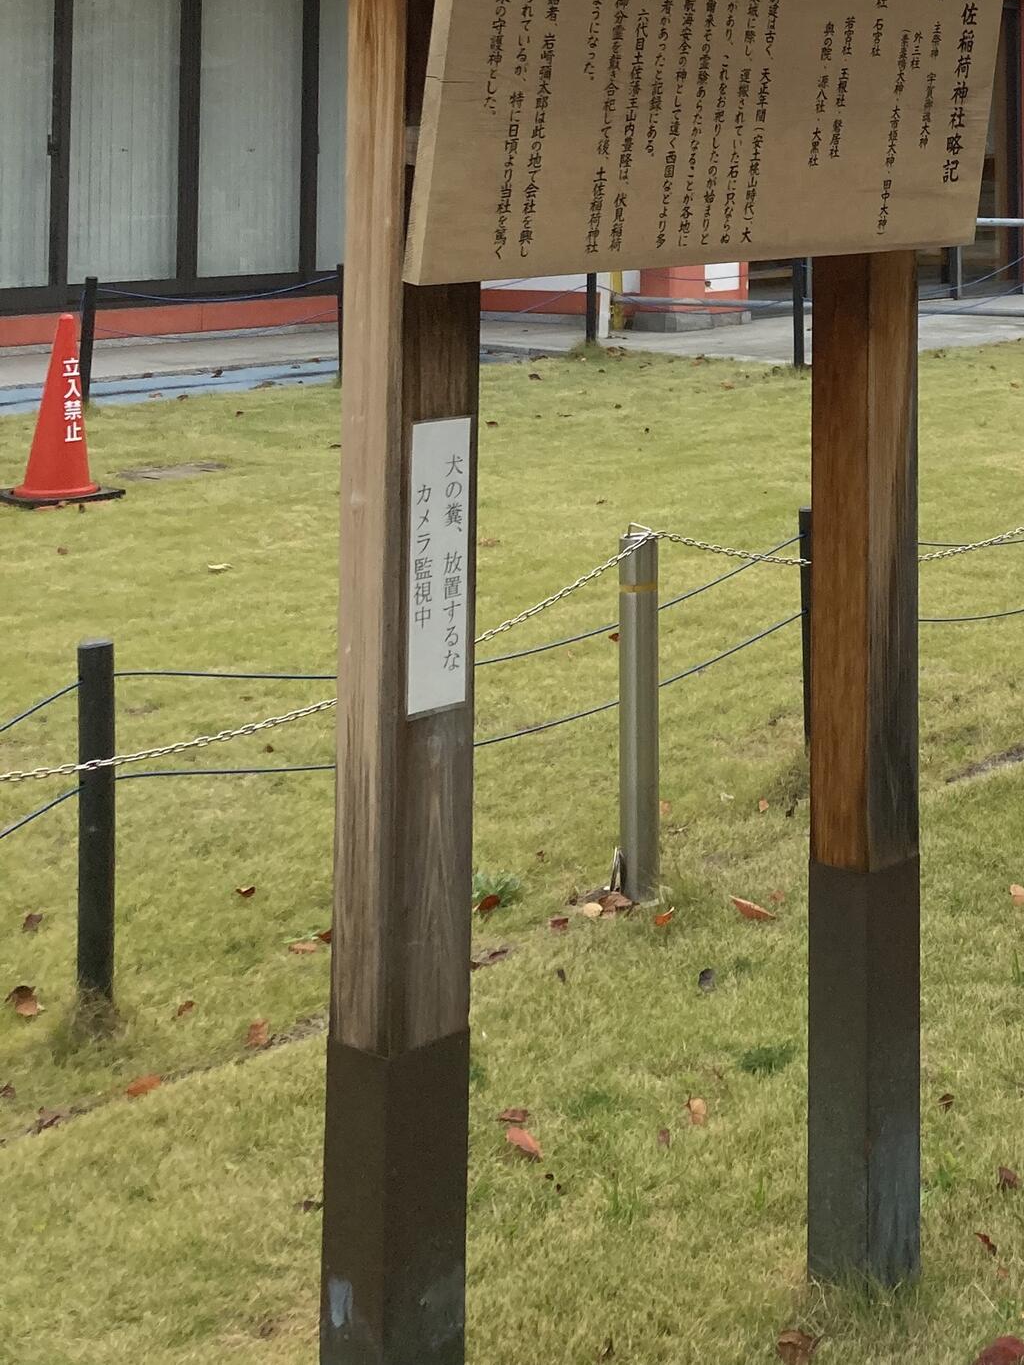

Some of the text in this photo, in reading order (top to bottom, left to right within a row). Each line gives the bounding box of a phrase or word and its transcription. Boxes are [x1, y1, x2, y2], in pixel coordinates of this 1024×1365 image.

[870, 18, 884, 58] 石宮社
[910, 31, 923, 69] 外三柱
[63, 357, 83, 442] 立入禁止
[414, 484, 433, 630] カメラ監視中
